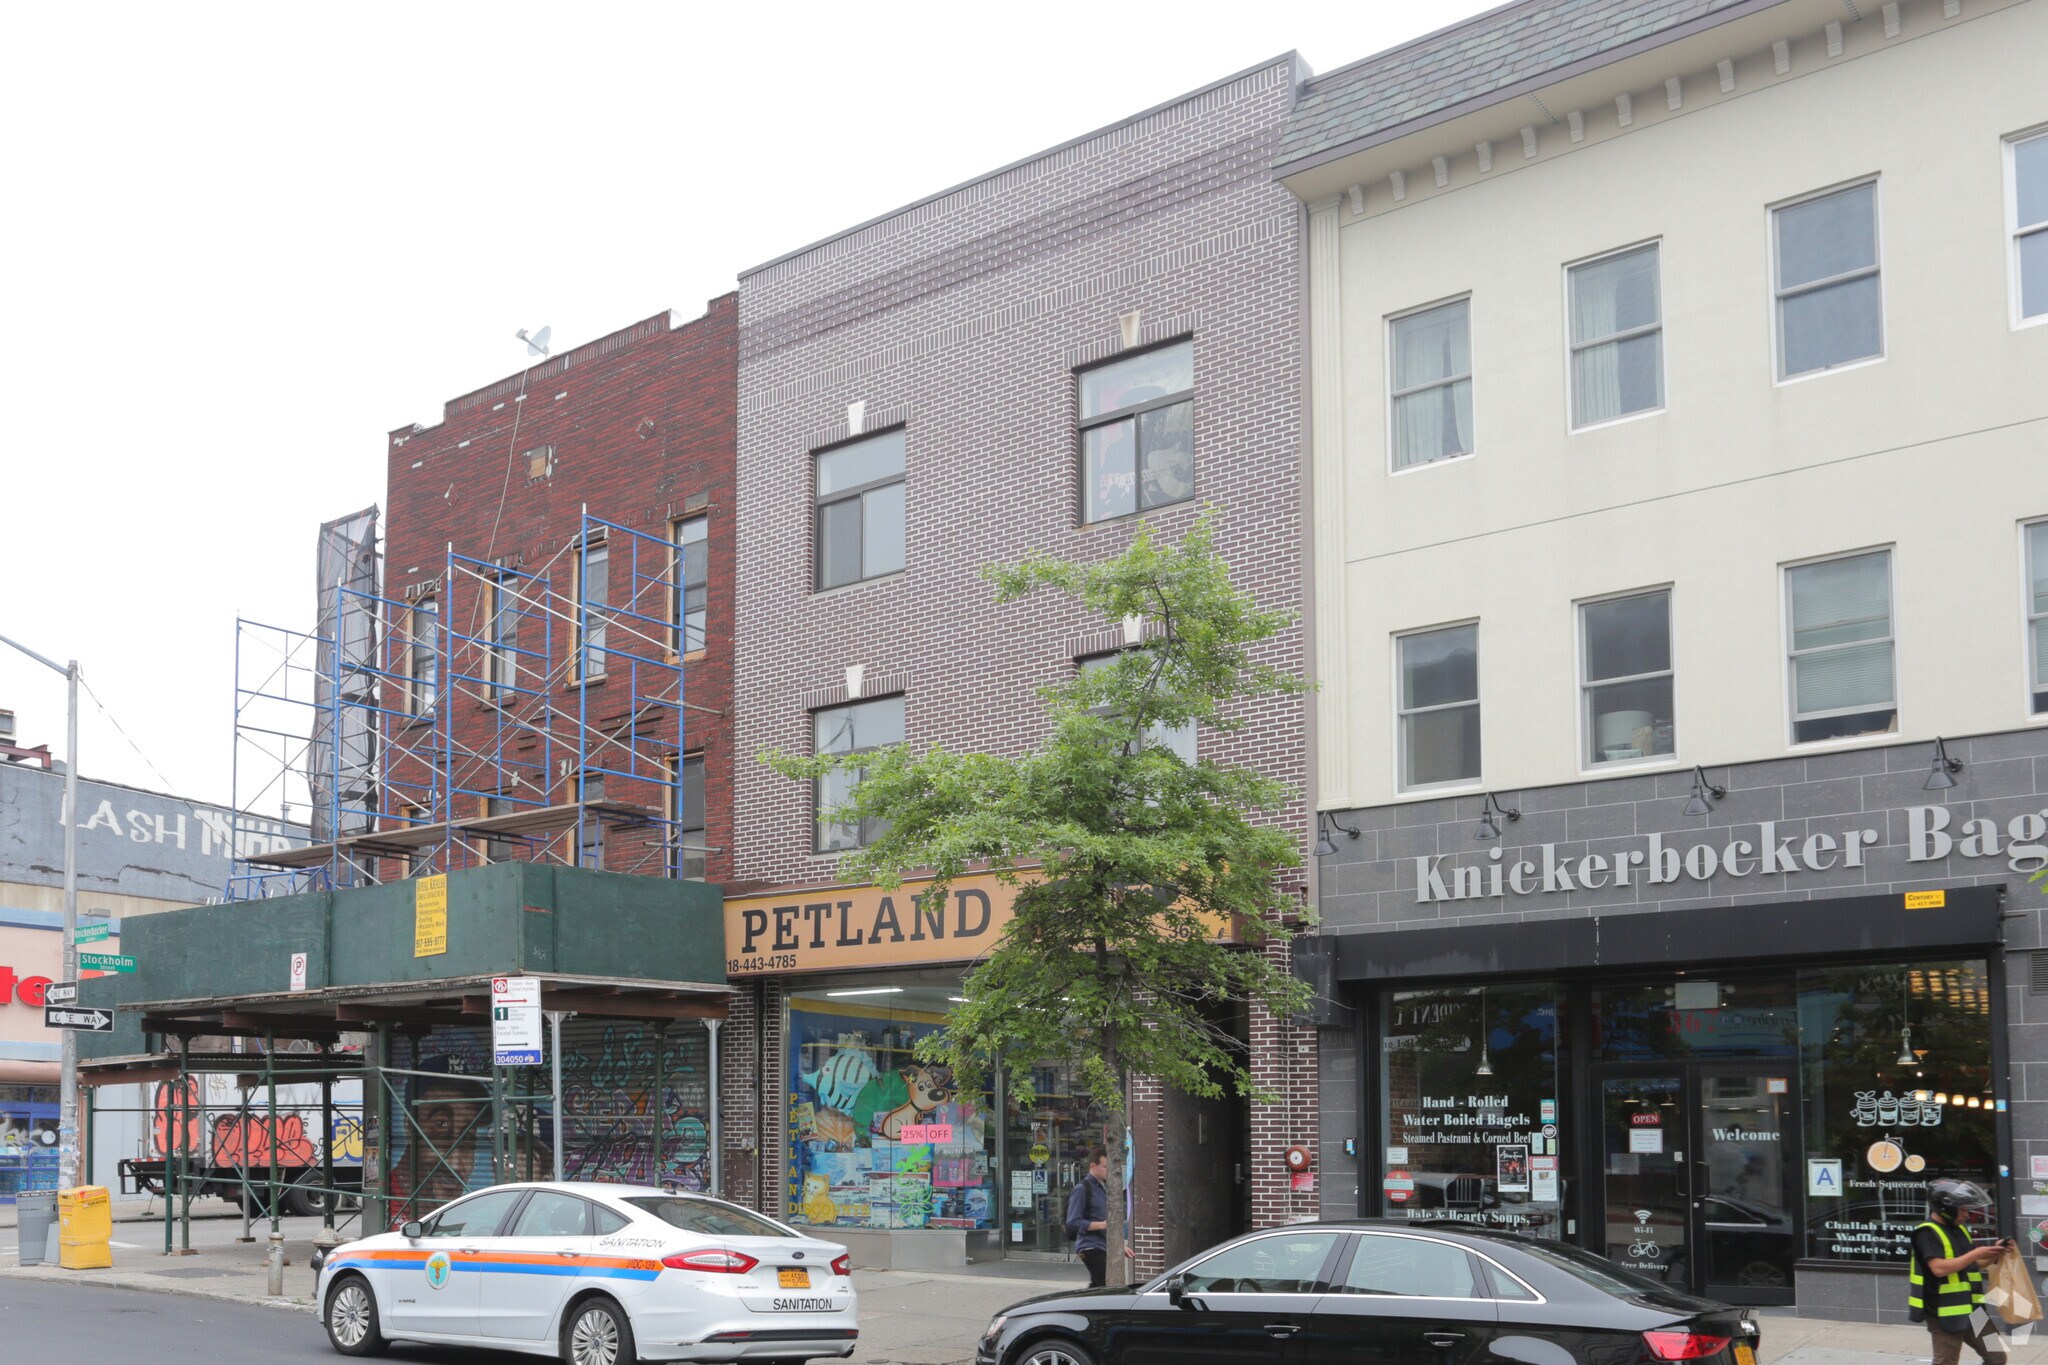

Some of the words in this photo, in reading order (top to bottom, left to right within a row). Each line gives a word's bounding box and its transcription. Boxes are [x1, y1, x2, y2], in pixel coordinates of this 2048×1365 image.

[1413, 821, 1878, 903] Knickerbocker
[742, 888, 992, 953] PETLAND
[75, 925, 108, 938] Knickerbocker
[82, 954, 133, 967] Stockholm
[726, 954, 797, 973] 18-443-4785
[50, 989, 60, 999] ONE
[63, 988, 73, 998] WAY
[55, 1014, 74, 1023] OE
[83, 1015, 103, 1024] WAY
[498, 1008, 504, 1020] 1
[496, 1055, 524, 1063] 304050
[1423, 1095, 1455, 1108] Hand
[1468, 1095, 1509, 1108] Rolled
[1403, 1114, 1440, 1126] Water
[1444, 1113, 1483, 1126] Boiled
[1487, 1113, 1531, 1128] Bagels
[1633, 1115, 1658, 1124] OPEN
[904, 1130, 924, 1139] 25%
[929, 1128, 949, 1139] OFF
[1403, 1131, 1436, 1144] Steamed
[1437, 1131, 1472, 1144] Pastrami
[1474, 1132, 1480, 1144] &
[1482, 1131, 1512, 1144] Corned
[1514, 1131, 1532, 1144] Beef
[1712, 1128, 1781, 1141] Welcome
[1816, 1167, 1834, 1186] A
[1850, 1179, 1876, 1188] Fresh
[1879, 1179, 1926, 1190] Squeezed
[1407, 1209, 1432, 1219] Hale
[1450, 1210, 1488, 1223] Hearty
[1492, 1211, 1530, 1226] Soups,
[1634, 1226, 1654, 1234] Wi-Fi
[1825, 1220, 1879, 1231] Challah
[1882, 1221, 1917, 1232] Fren
[599, 1237, 667, 1248] SANITATION
[1836, 1232, 1890, 1244] Waffles,
[1832, 1244, 1891, 1255] Omelets,
[1896, 1245, 1908, 1255] &
[1639, 1261, 1669, 1272] Delivery
[773, 1298, 832, 1311] SANITATION
